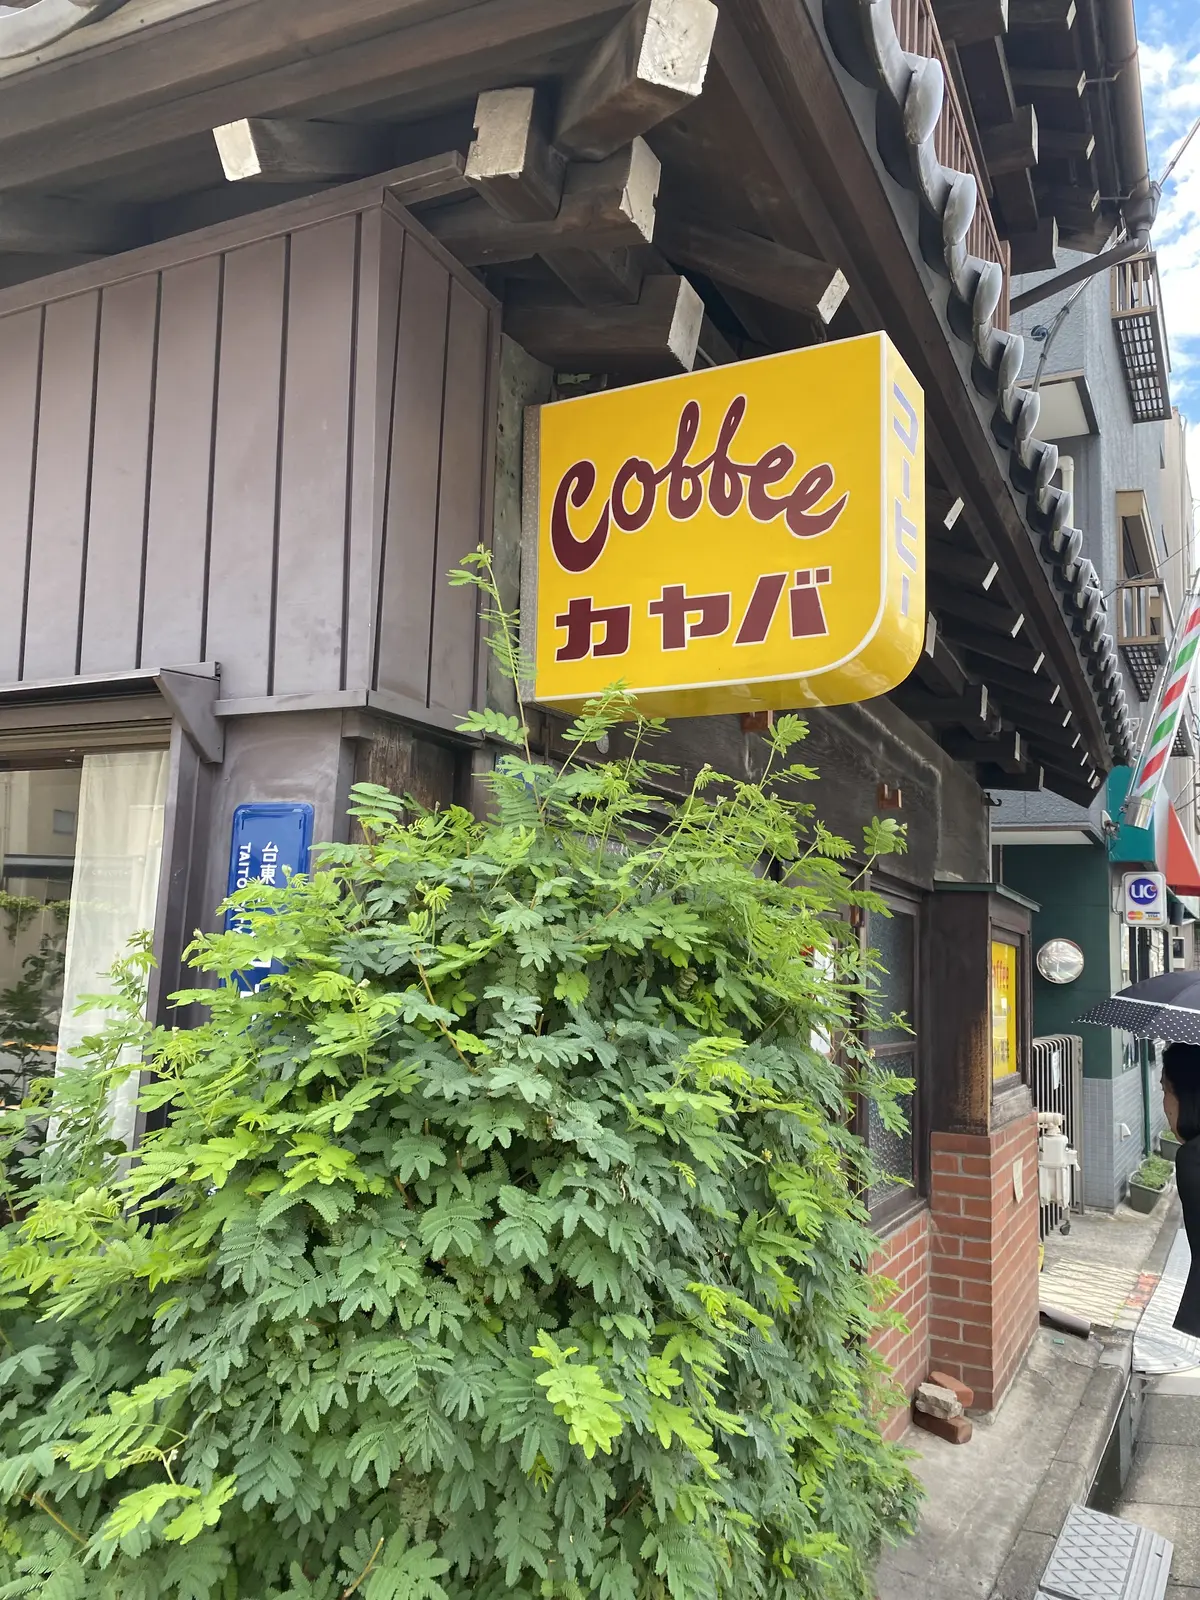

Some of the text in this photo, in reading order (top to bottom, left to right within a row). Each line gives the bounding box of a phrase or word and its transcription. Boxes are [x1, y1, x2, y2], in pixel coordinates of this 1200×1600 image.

[550, 394, 850, 574] Coffee
[893, 382, 919, 617] コーヒー
[554, 566, 832, 662] カヤバ
[236, 842, 252, 888] TAITO
[260, 841, 279, 901] 台東
[1131, 884, 1157, 899] UC
